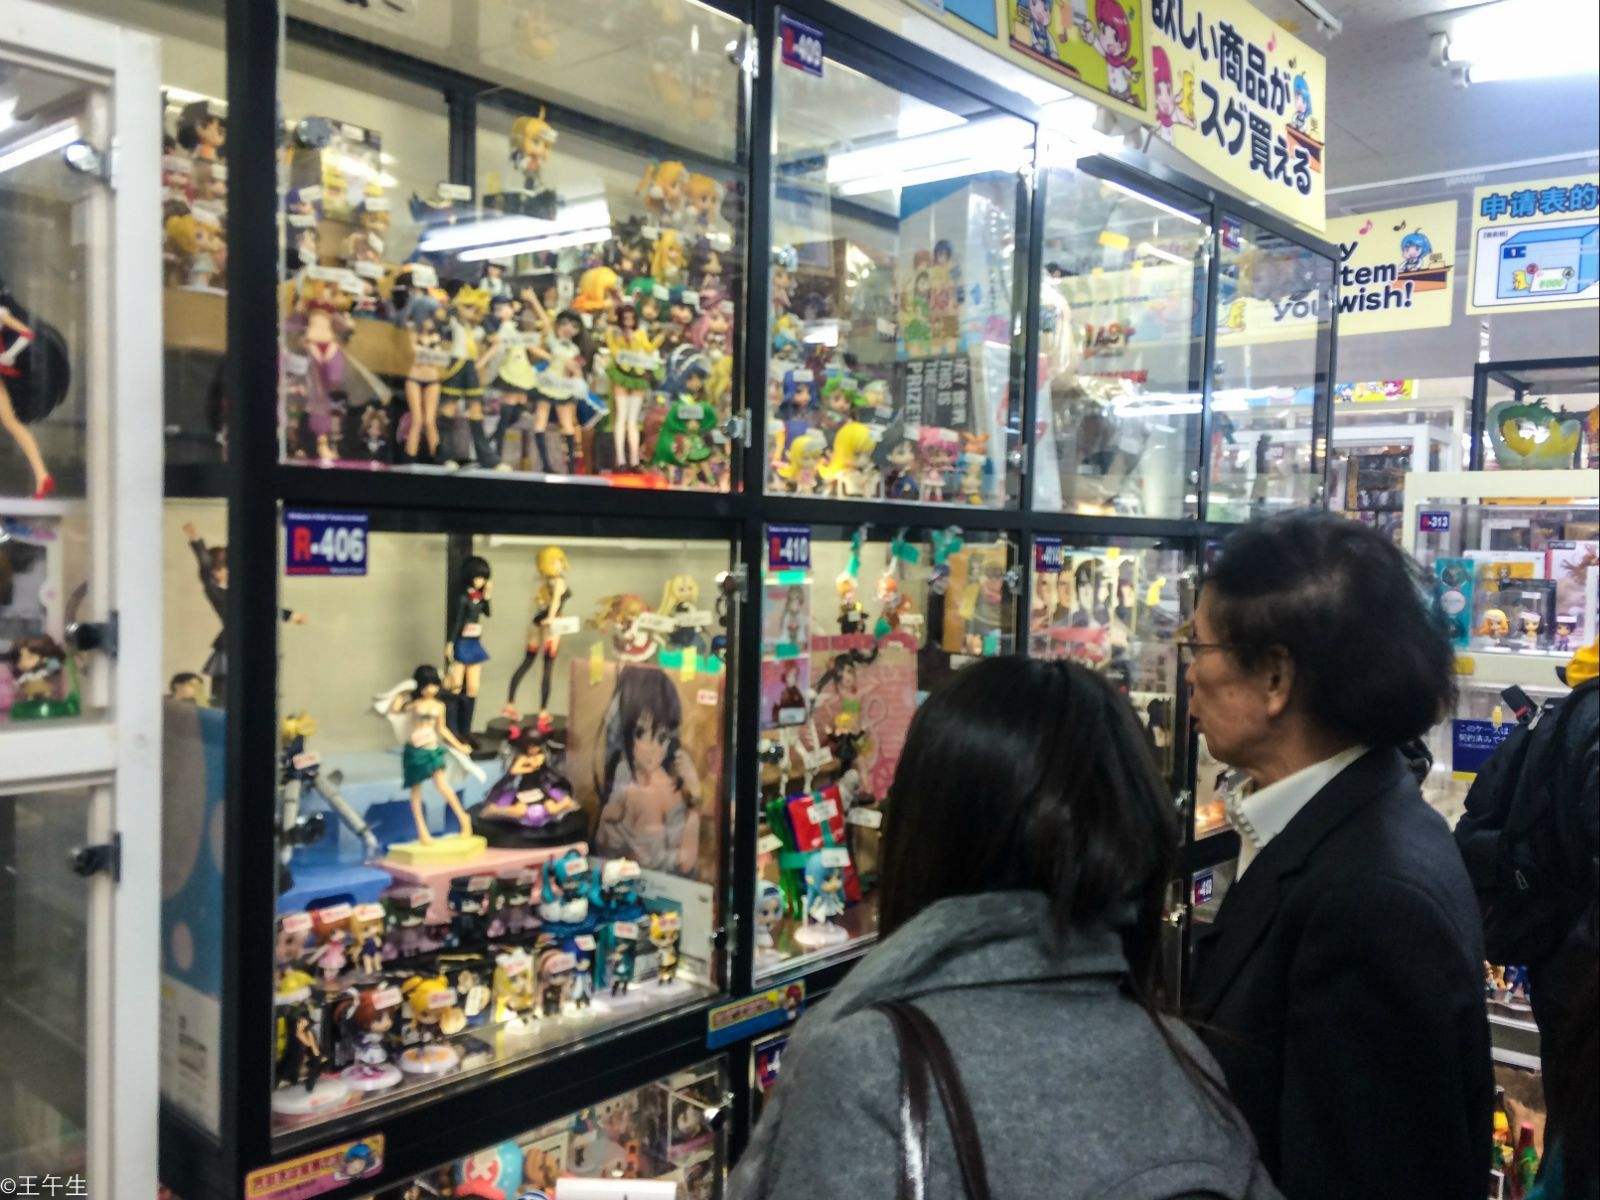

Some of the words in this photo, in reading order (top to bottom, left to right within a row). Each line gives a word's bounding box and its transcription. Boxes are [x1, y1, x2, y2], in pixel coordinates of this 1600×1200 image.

[1201, 80, 1312, 195] スグ買える
[1481, 183, 1599, 220] 申请表的
[1337, 282, 1413, 314] wish!
[293, 527, 365, 562] R-406
